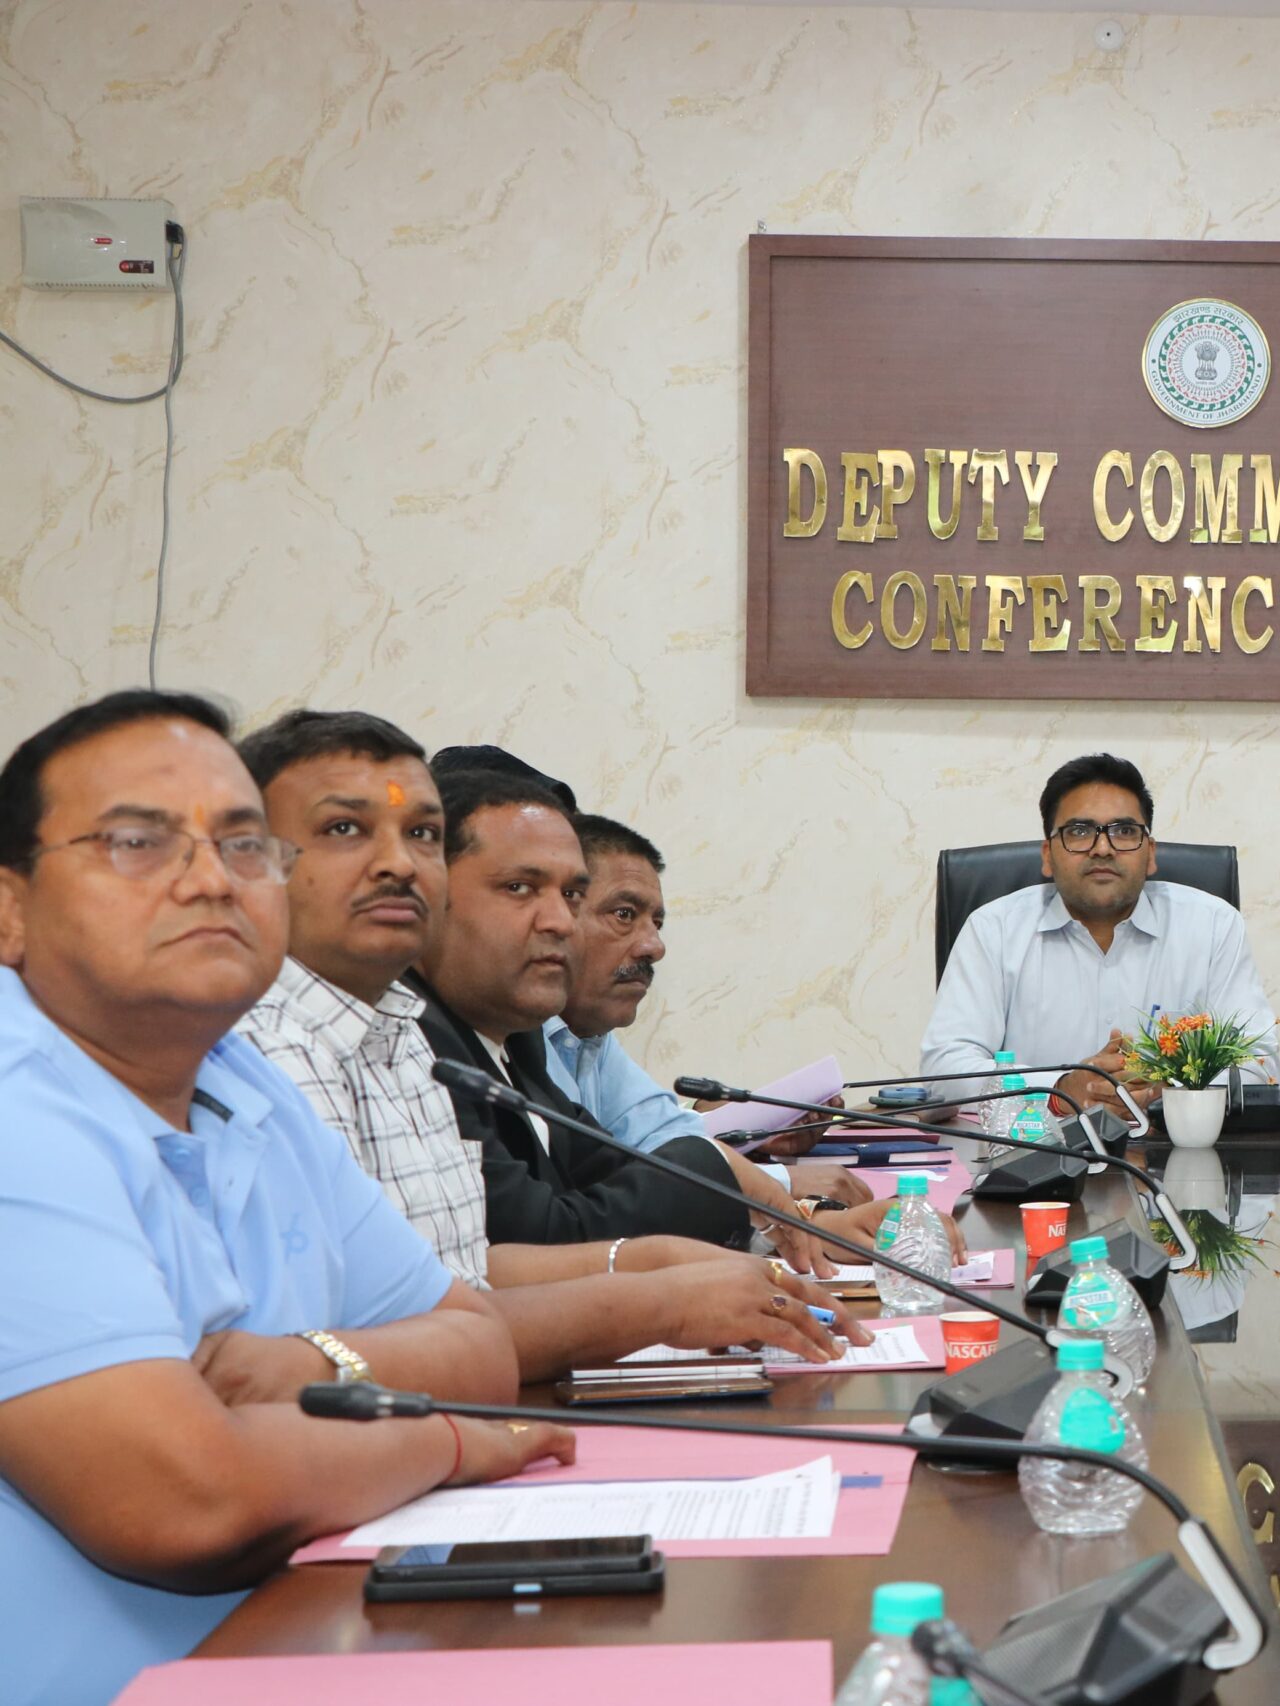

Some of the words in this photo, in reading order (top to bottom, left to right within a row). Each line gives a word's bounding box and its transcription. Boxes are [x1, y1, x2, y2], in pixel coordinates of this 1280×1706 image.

[1213, 306, 1245, 325] सरकार
[1151, 370, 1200, 419] GOVERNMENT
[1216, 374, 1261, 419] JHARKHAND
[782, 448, 1058, 544] DEPUTY
